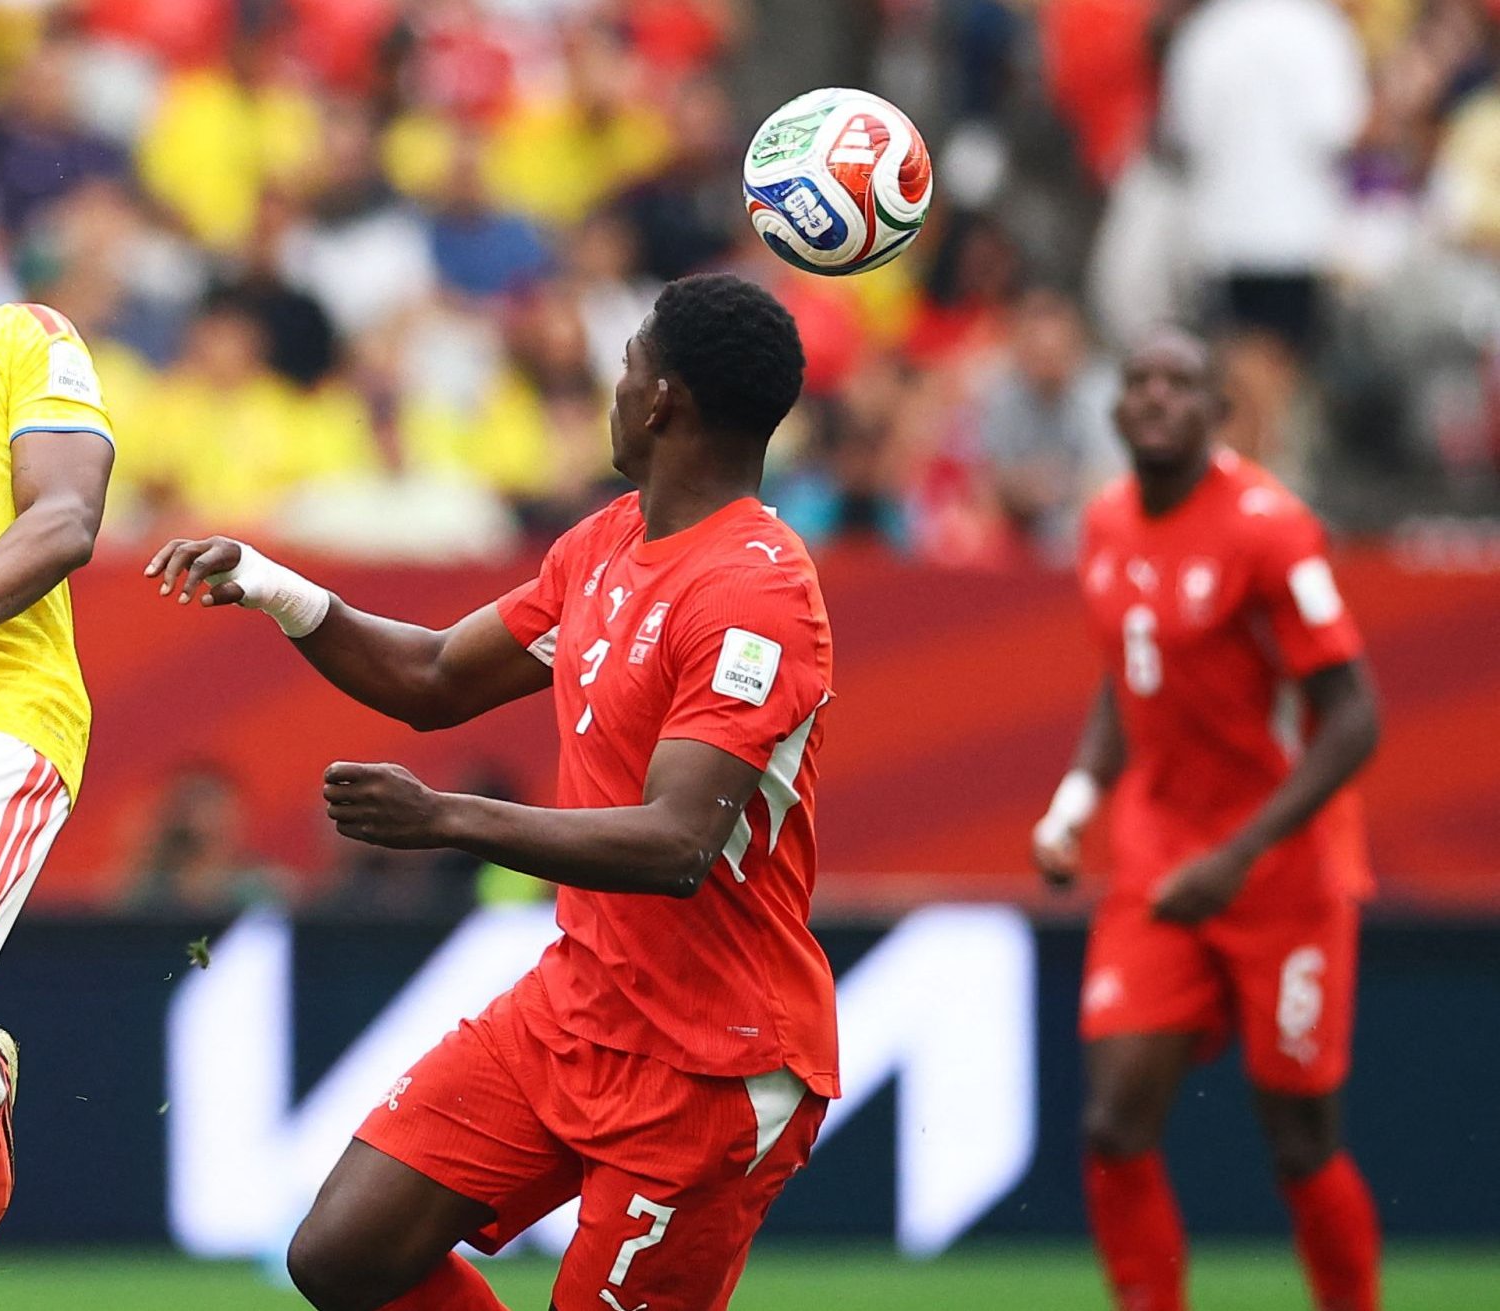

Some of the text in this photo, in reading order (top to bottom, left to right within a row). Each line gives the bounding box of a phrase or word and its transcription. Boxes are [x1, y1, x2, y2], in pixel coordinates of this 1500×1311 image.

[725, 670, 762, 690] EDUCATION
[1276, 945, 1327, 1038] 6
[608, 1193, 677, 1287] 7
